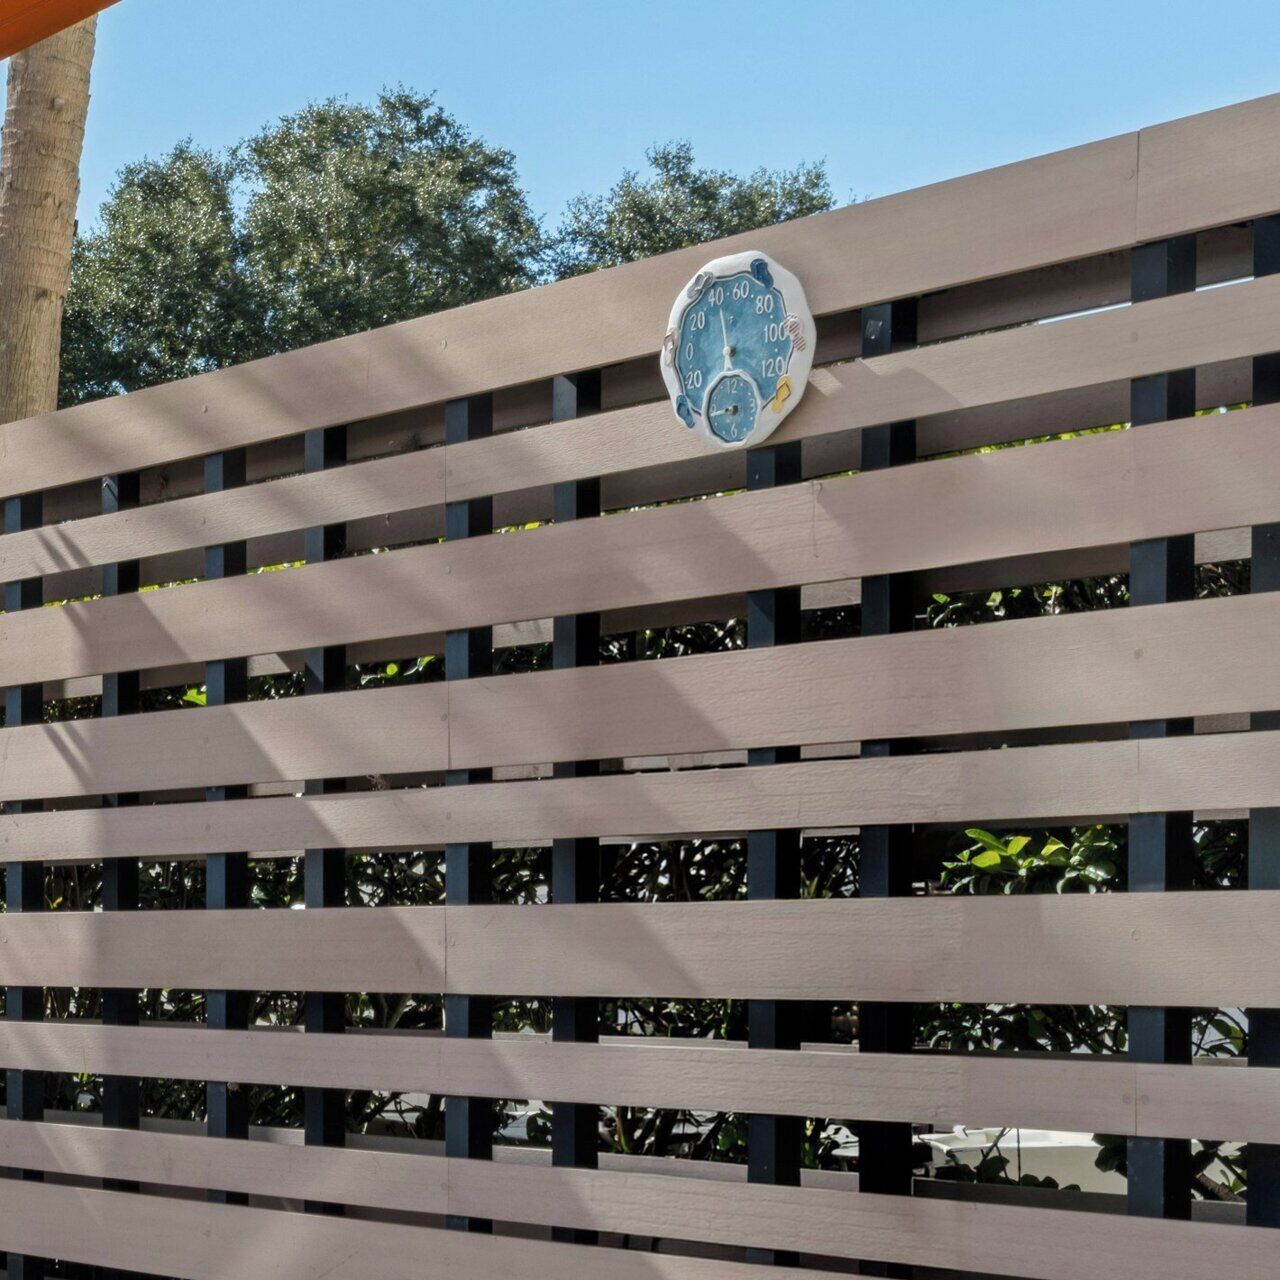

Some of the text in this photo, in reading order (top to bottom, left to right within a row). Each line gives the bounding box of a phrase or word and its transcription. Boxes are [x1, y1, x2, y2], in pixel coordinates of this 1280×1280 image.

[708, 286, 724, 307] 40
[732, 280, 749, 300] 60
[755, 294, 774, 314] 80
[690, 311, 705, 331] 20
[763, 322, 788, 343] 100
[685, 342, 694, 361] 0
[761, 356, 786, 378] 120
[726, 379, 738, 395] 12
[748, 398, 757, 413] 3
[730, 422, 738, 438] 6
